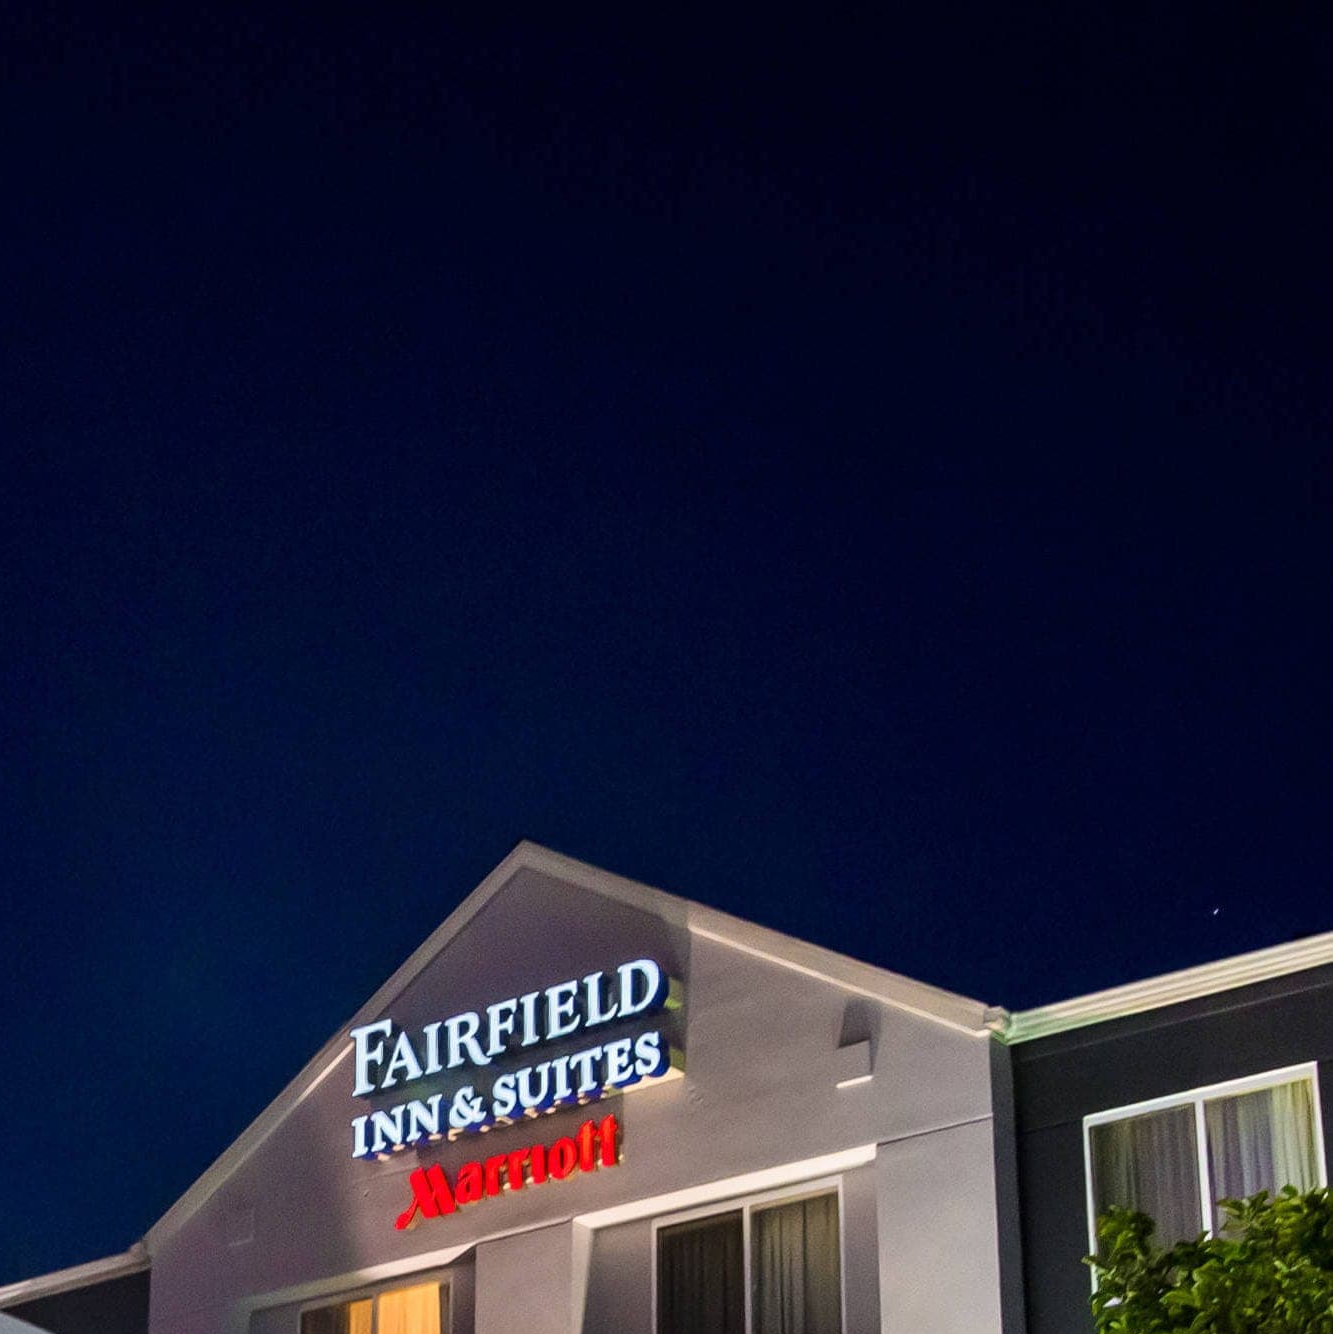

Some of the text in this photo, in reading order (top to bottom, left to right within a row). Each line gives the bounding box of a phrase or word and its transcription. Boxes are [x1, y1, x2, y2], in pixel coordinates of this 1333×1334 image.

[350, 959, 660, 1097] FAIRFIELD
[351, 1031, 661, 1158] INN & SUITES
[393, 1114, 618, 1231] Marriott
